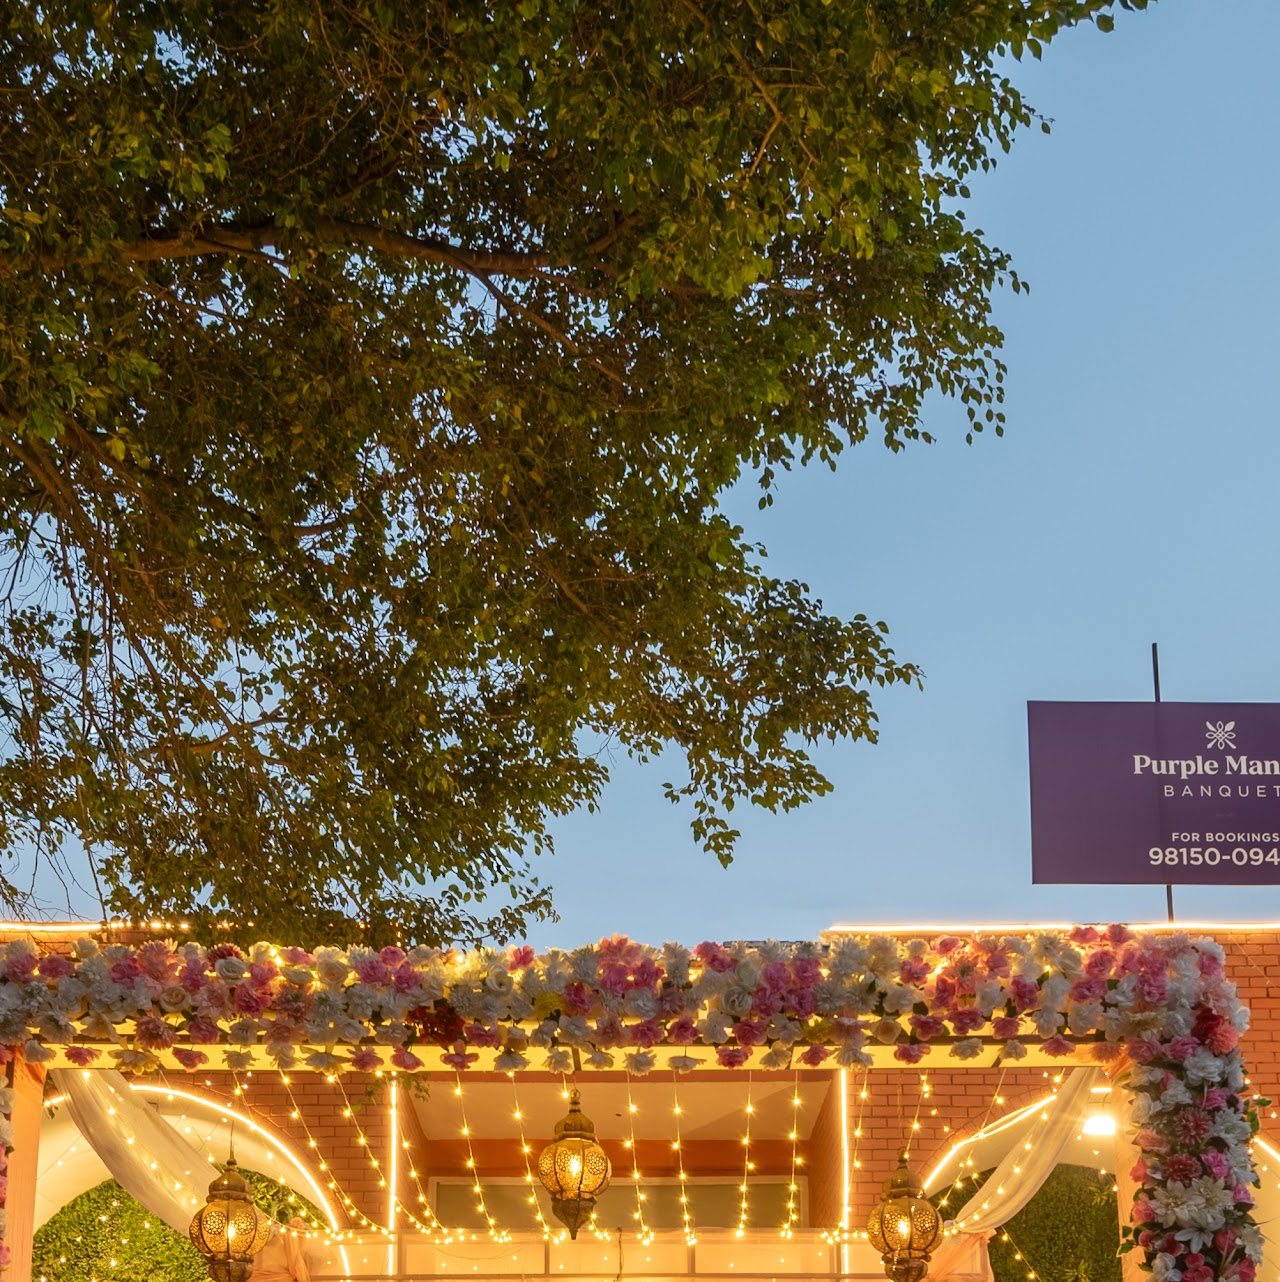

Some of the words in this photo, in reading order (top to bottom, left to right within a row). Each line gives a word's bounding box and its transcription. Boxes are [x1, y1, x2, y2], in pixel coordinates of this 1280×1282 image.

[1133, 754, 1219, 780] Purple
[1171, 832, 1200, 842] FOR
[1205, 832, 1280, 843] BOOKINGS
